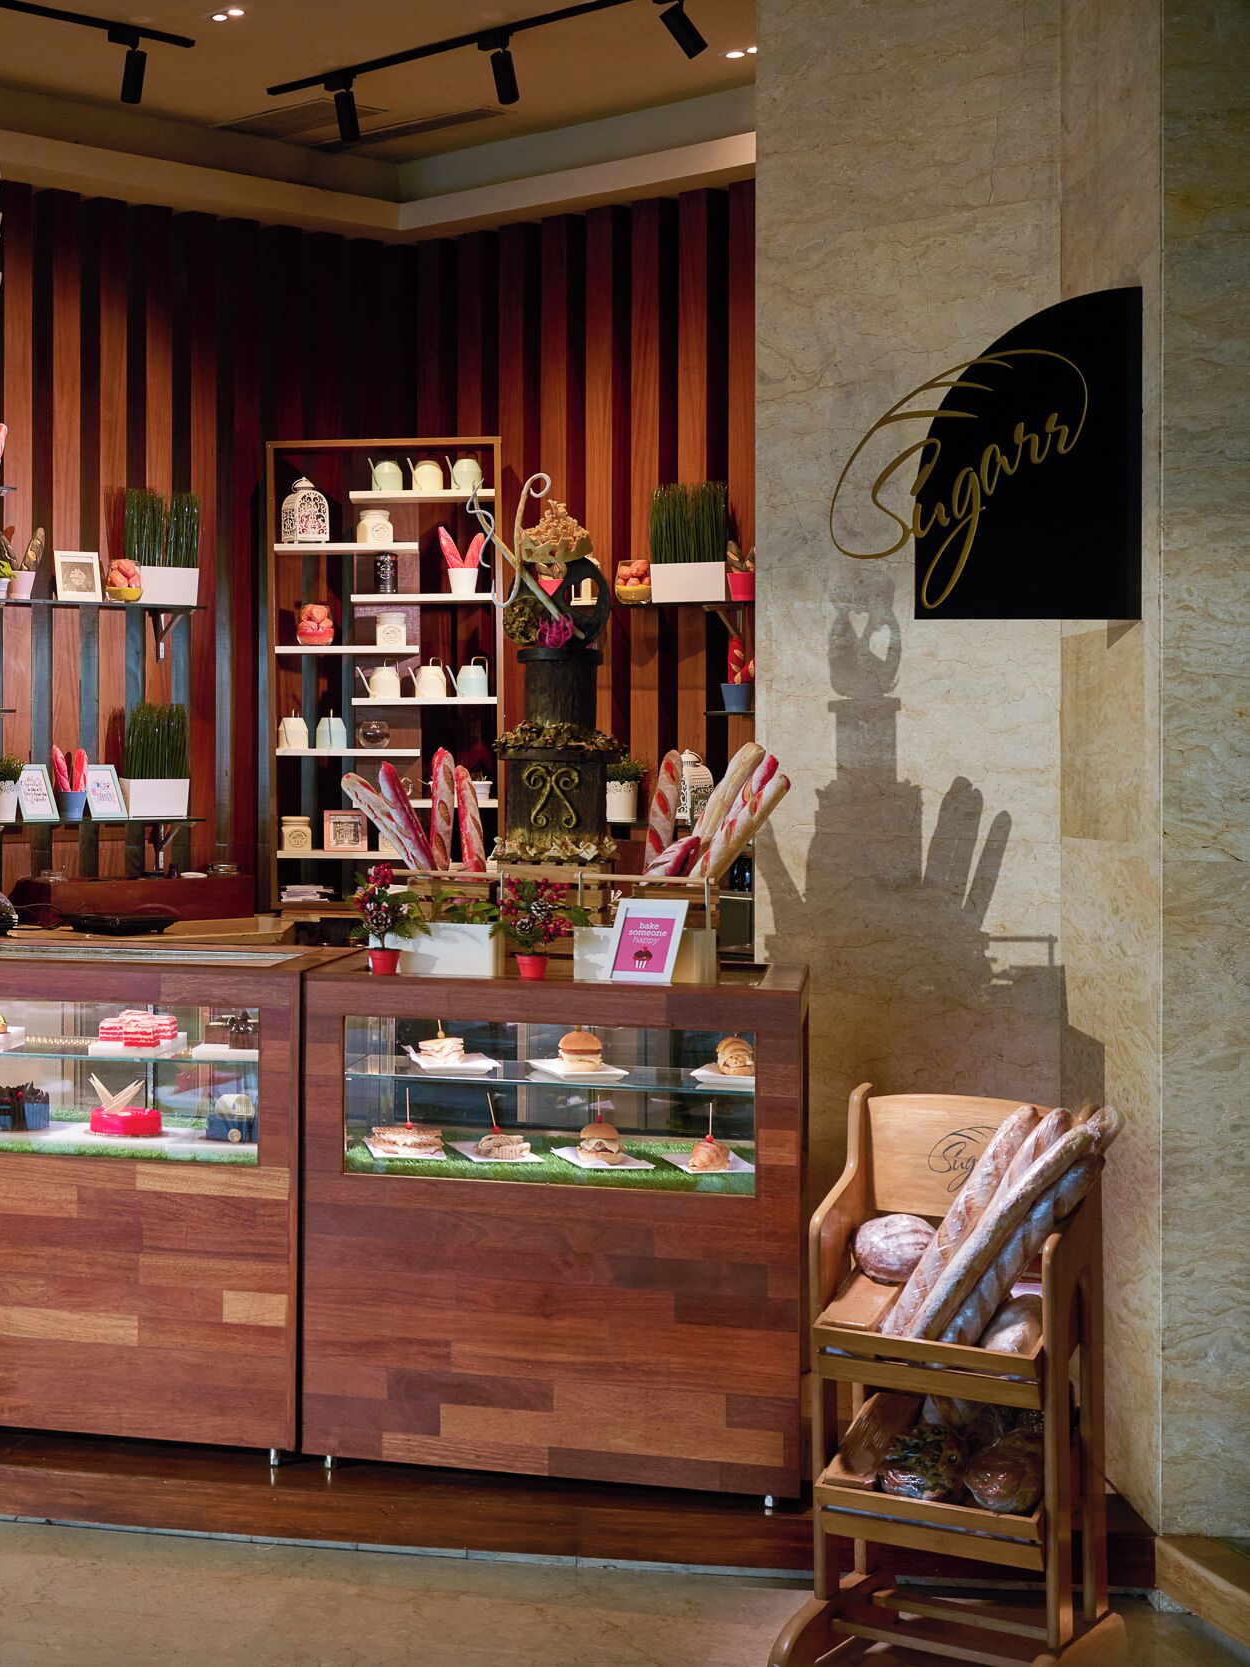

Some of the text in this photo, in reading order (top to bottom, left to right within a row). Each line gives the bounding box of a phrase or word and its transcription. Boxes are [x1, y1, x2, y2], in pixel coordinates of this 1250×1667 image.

[829, 375, 1087, 609] Sugarr
[639, 922, 659, 930] bake
[628, 929, 667, 937] someone
[632, 936, 660, 945] happy
[928, 1133, 982, 1192] Sug
